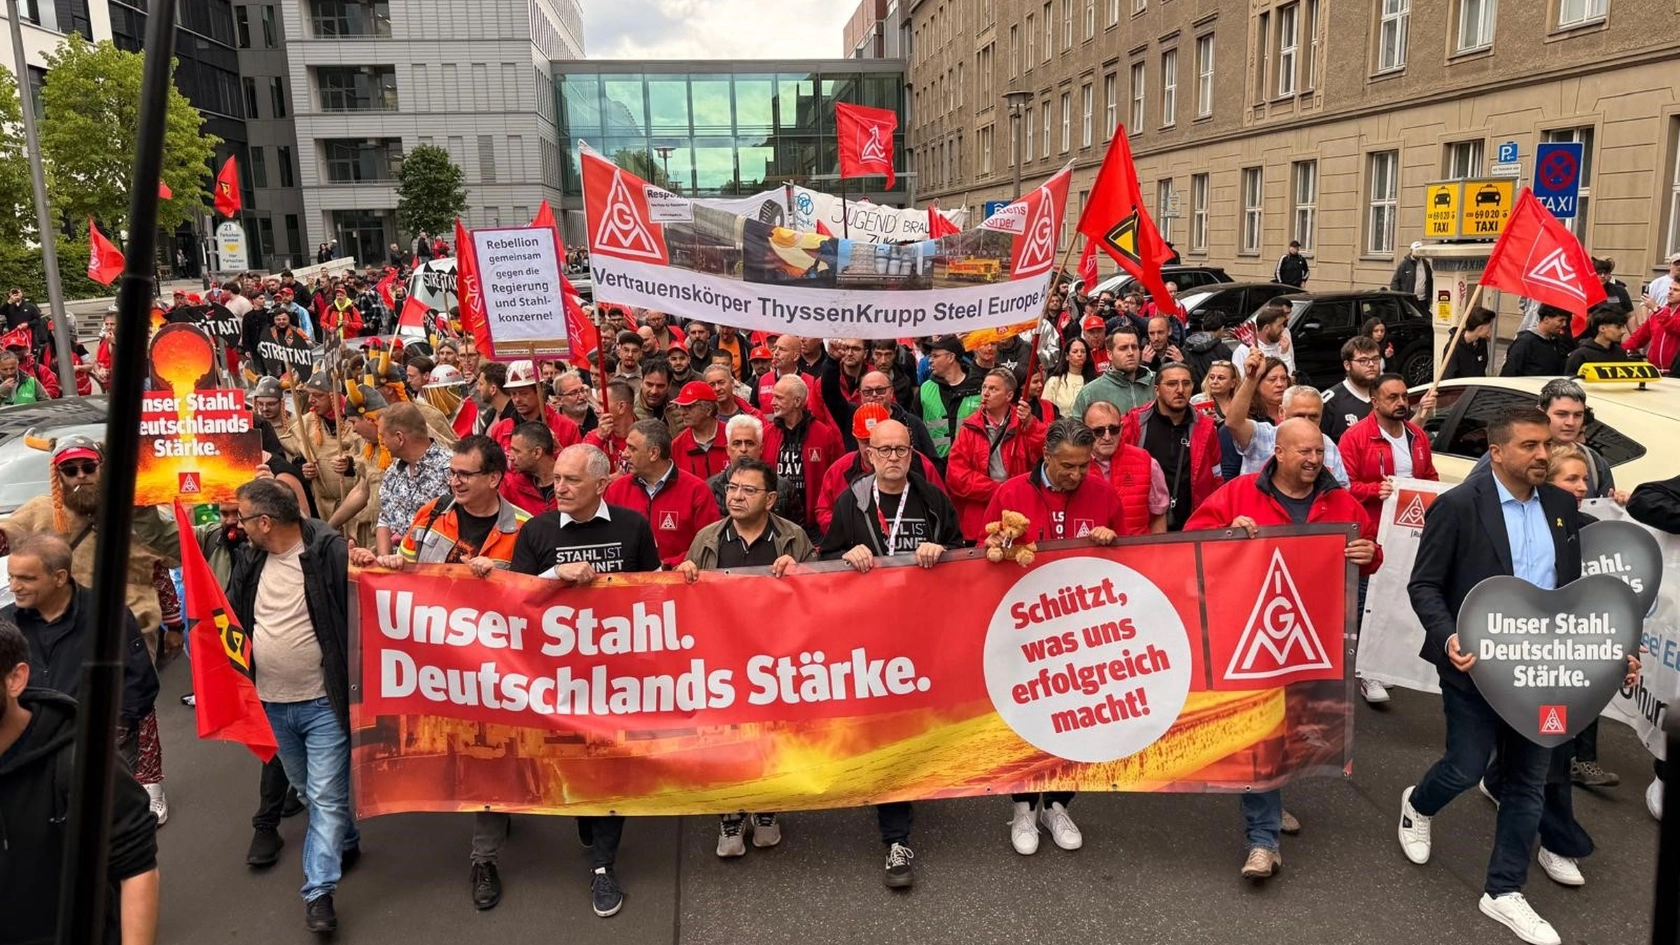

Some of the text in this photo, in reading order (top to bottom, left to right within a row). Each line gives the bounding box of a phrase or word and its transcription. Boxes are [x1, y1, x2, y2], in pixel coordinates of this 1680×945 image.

[1501, 146, 1512, 161] P
[1433, 222, 1449, 233] TAXI
[1475, 220, 1499, 232] TAXI
[487, 237, 539, 249] Rebellion
[489, 252, 541, 265] gemeinsam
[496, 267, 540, 280] gegen die
[491, 281, 549, 295] Regierung
[593, 267, 752, 313] Vertrauenskörper
[757, 296, 926, 327] ThyssenKrupp
[933, 298, 982, 321] Steel
[988, 290, 1039, 315] Europe
[495, 295, 552, 308] und Stahl-
[498, 311, 553, 323] konzerne!
[1601, 366, 1652, 378] TAXI
[142, 392, 242, 413] nser Stahl.
[139, 413, 249, 436] eutschlands
[153, 438, 221, 457] Stärke.
[556, 546, 622, 563] STAHL IST
[1580, 553, 1632, 576] tahl.
[1010, 577, 1128, 630] Schützt,
[375, 589, 695, 657] Unser Stahl.
[1487, 612, 1616, 635] Unser Stahl.
[1021, 617, 1137, 663] was uns
[1479, 638, 1624, 661] Deutschlands
[380, 647, 931, 715] Deutschlands Stärke.
[1011, 643, 1171, 704] erfolgreich
[1513, 664, 1591, 687] Stärke.
[1050, 687, 1151, 733] macht!
